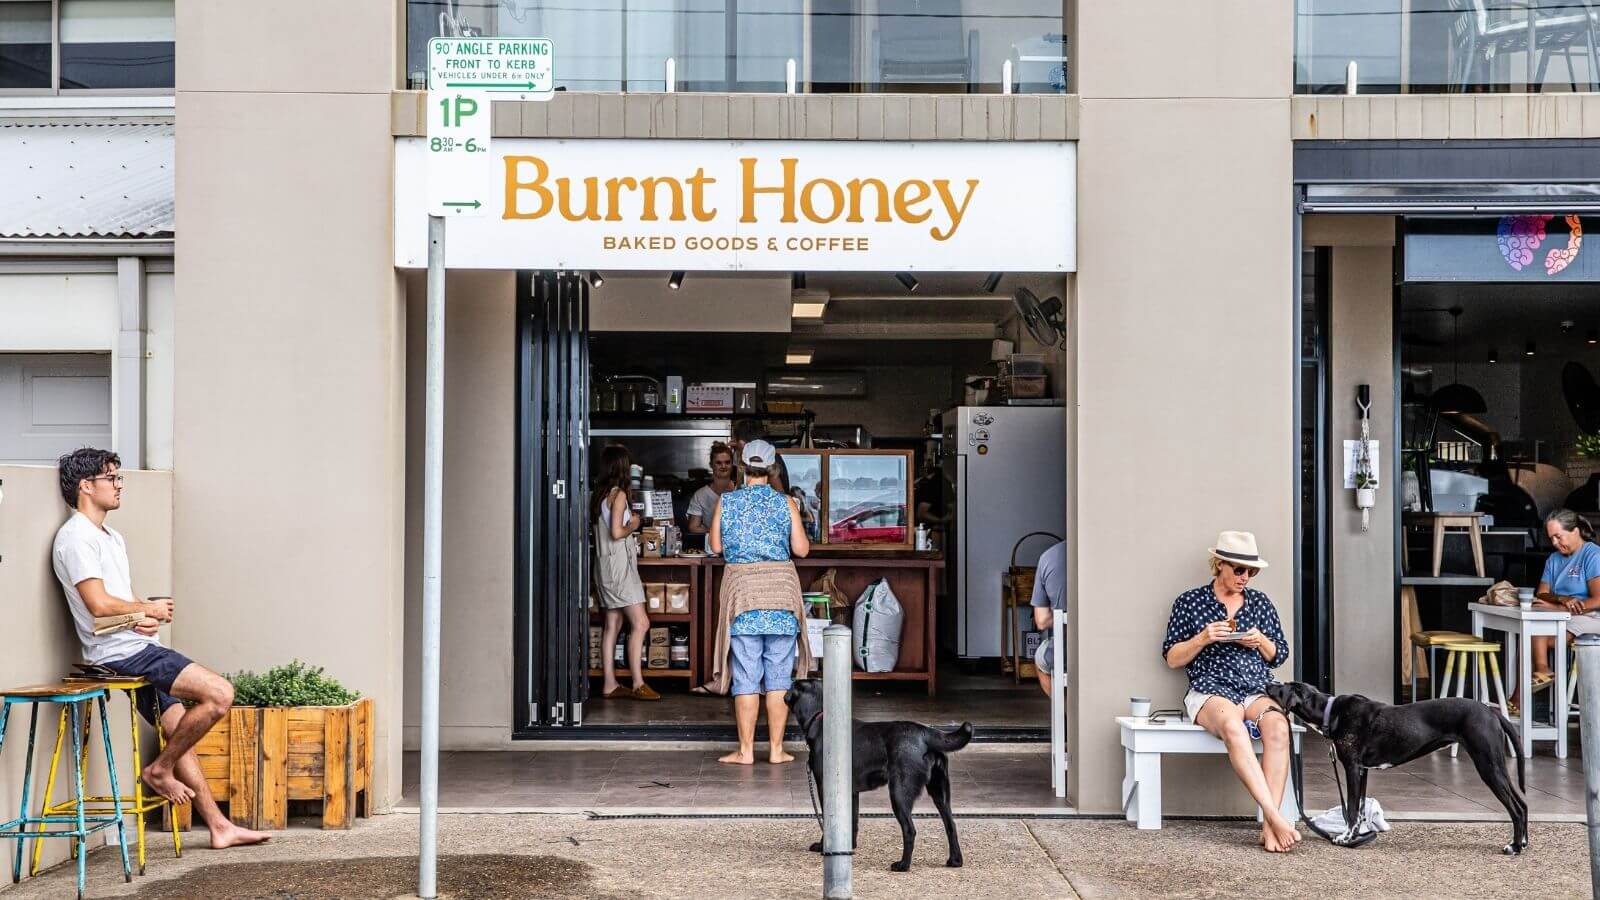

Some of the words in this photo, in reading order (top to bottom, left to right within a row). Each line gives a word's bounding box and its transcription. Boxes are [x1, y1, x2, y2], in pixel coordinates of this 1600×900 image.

[456, 42, 493, 56] ANGLE
[499, 43, 549, 56] PARKING
[446, 59, 481, 69] FRONT
[488, 59, 501, 69] TO
[507, 59, 536, 70] KERB
[525, 72, 545, 80] ONLY
[440, 97, 478, 128] 1P
[502, 155, 718, 222] Burnt
[738, 158, 980, 242] Honey
[603, 236, 676, 250] BAKED
[685, 236, 759, 251] GOODS
[767, 237, 779, 251] &
[786, 237, 869, 252] COFFEE
